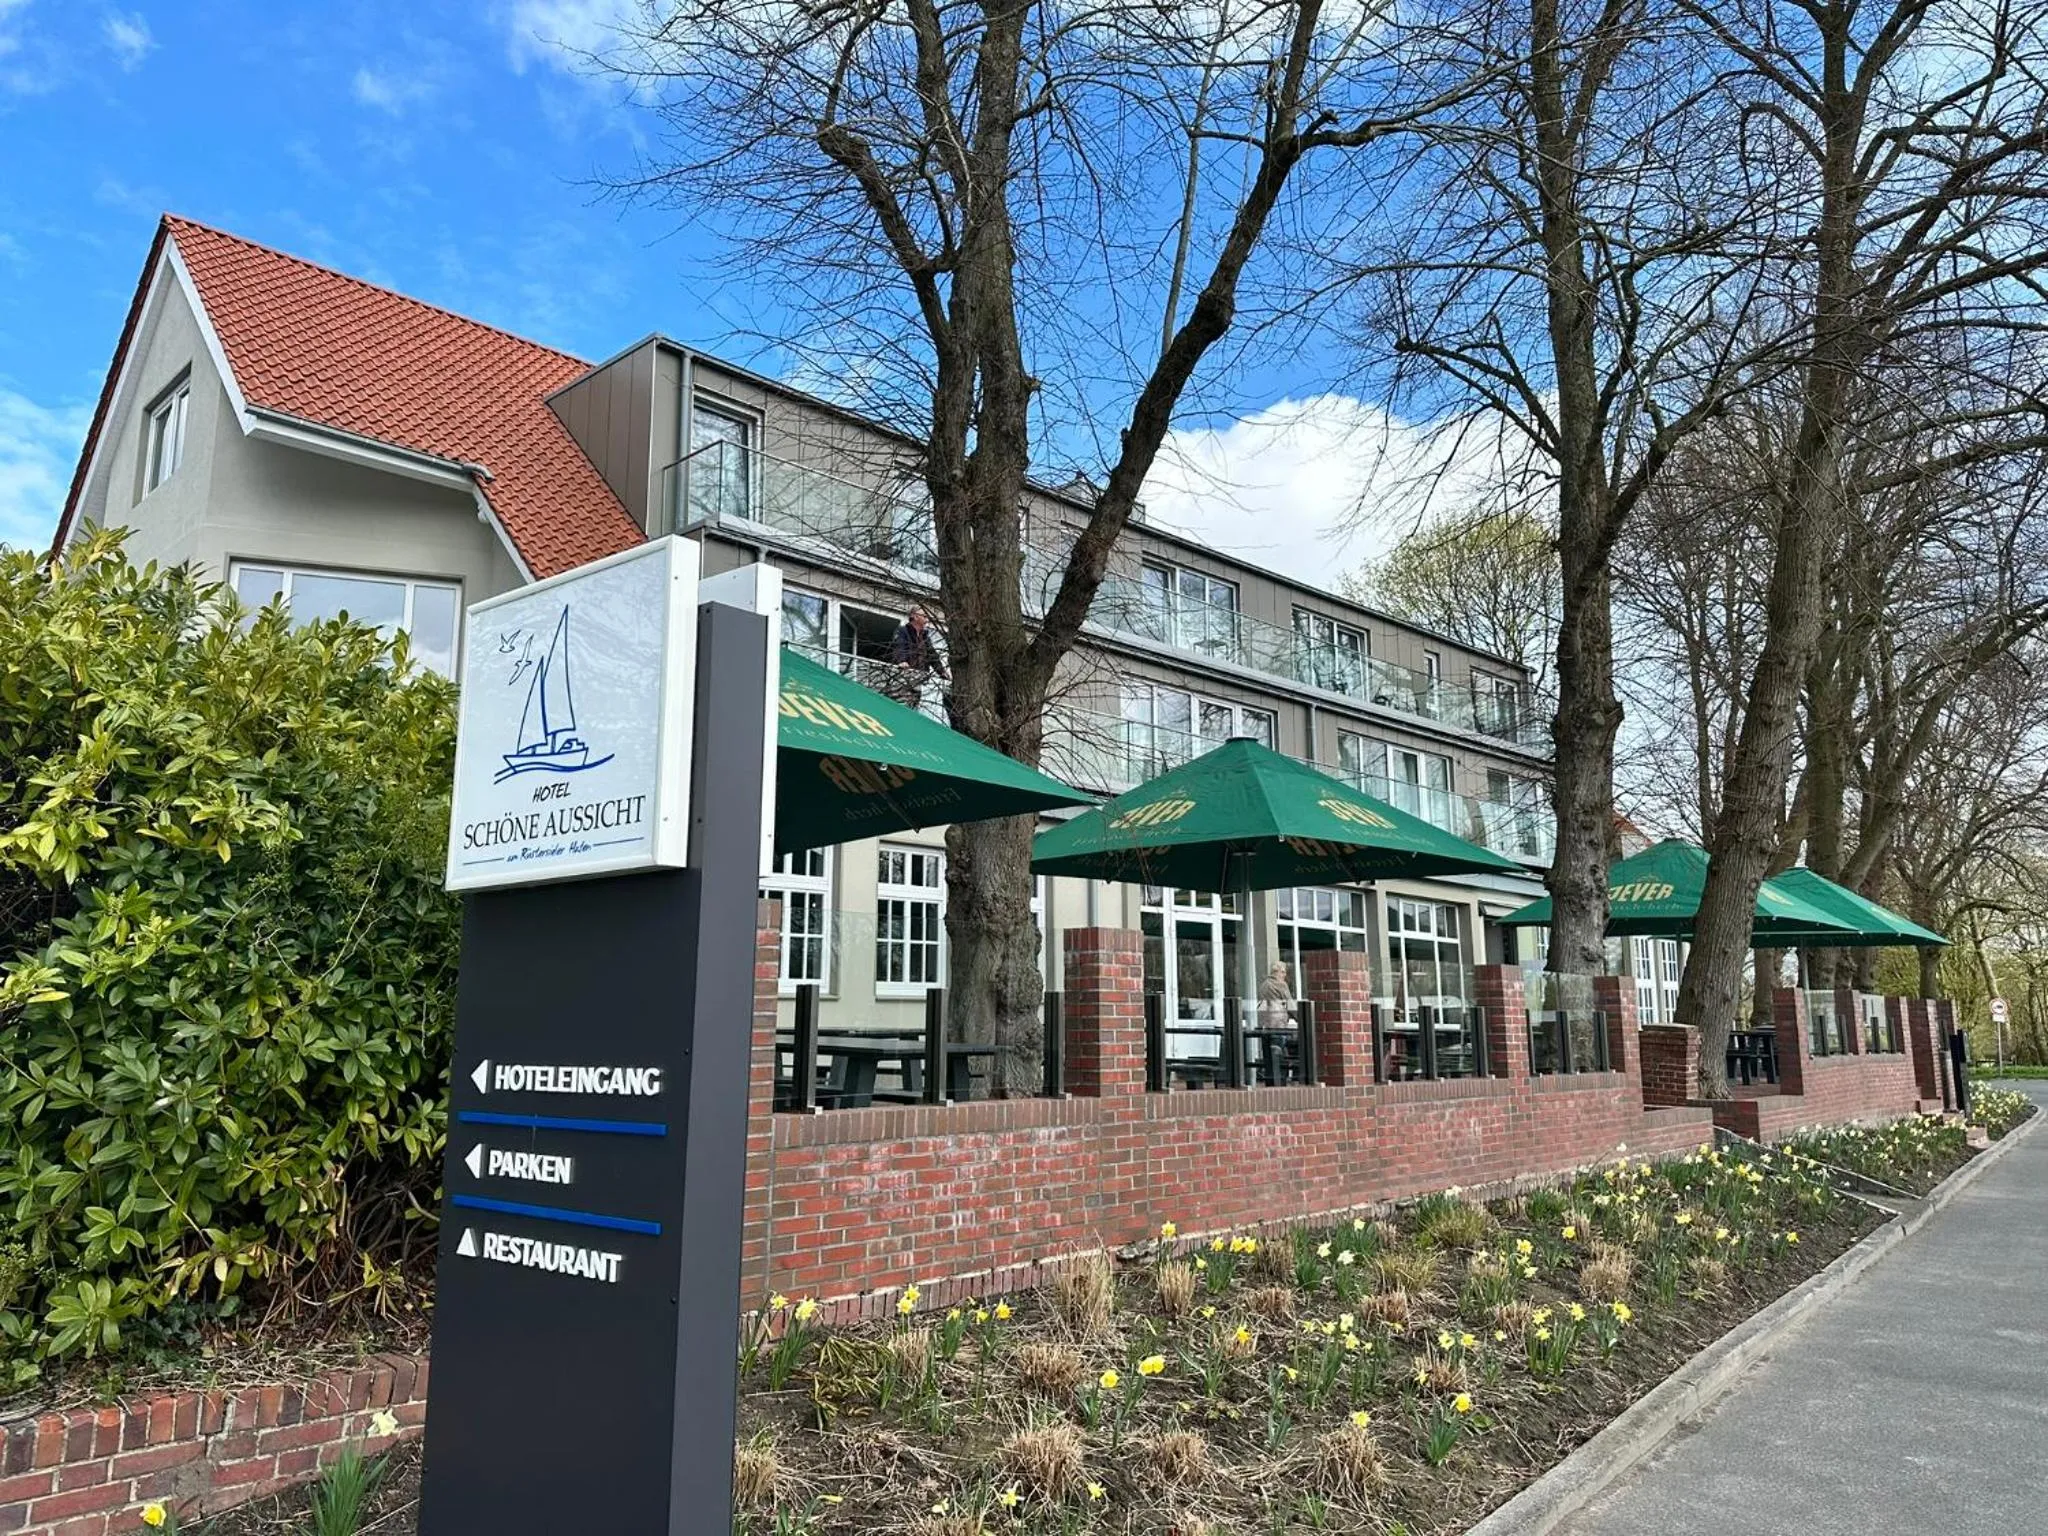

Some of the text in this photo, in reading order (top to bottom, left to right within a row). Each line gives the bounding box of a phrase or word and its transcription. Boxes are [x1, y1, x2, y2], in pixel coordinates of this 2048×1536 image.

[779, 691, 895, 737] JEVER
[532, 782, 571, 802] HOTEL
[463, 795, 646, 849] SCHÖNE AUSSICHT
[1607, 882, 1675, 902] JEVER
[494, 1064, 662, 1096] HOTELEINGANG
[488, 1150, 573, 1184] PARKEN
[483, 1232, 623, 1283] RESTAURANT
